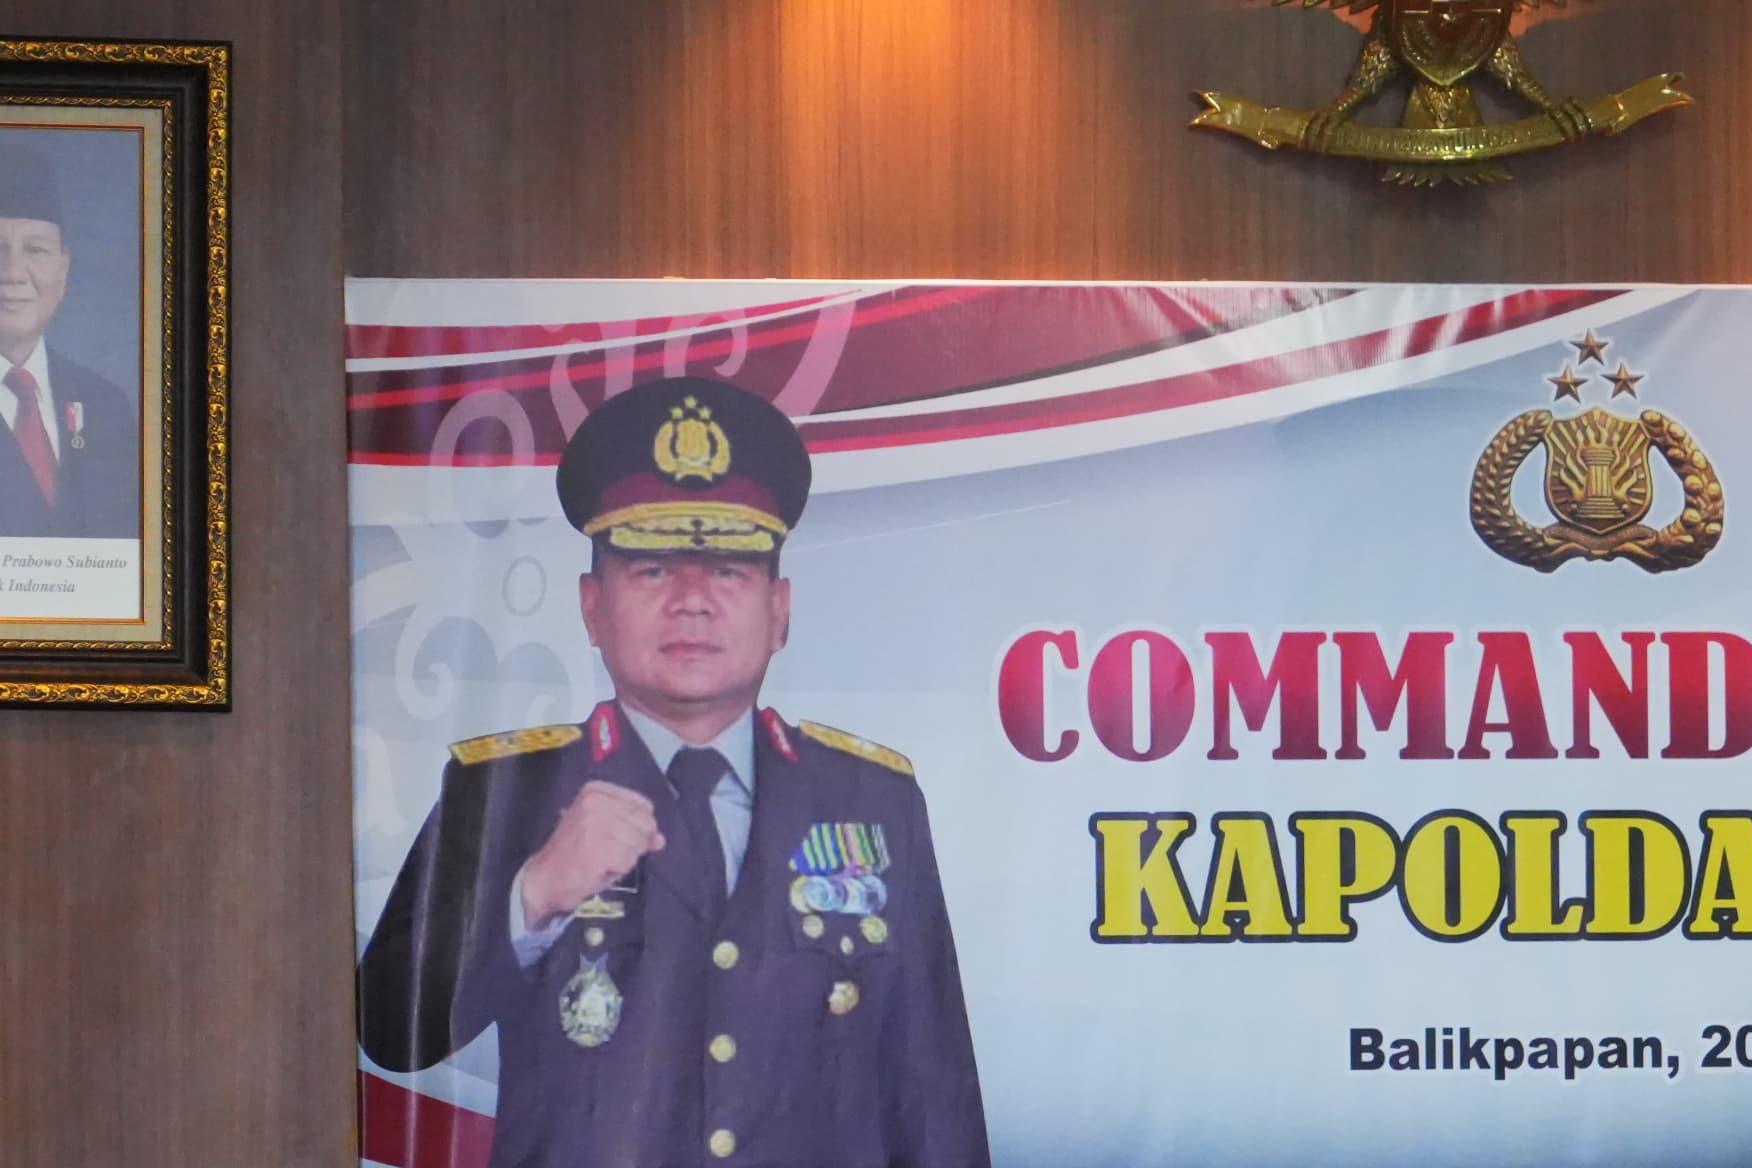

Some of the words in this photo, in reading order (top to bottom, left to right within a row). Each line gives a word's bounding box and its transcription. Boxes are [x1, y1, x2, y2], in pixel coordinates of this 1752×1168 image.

[2, 554, 62, 568] Prabowo
[66, 555, 127, 569] Subianto
[8, 579, 75, 592] Indonesia
[1348, 1024, 1681, 1080] Balikpapan,
